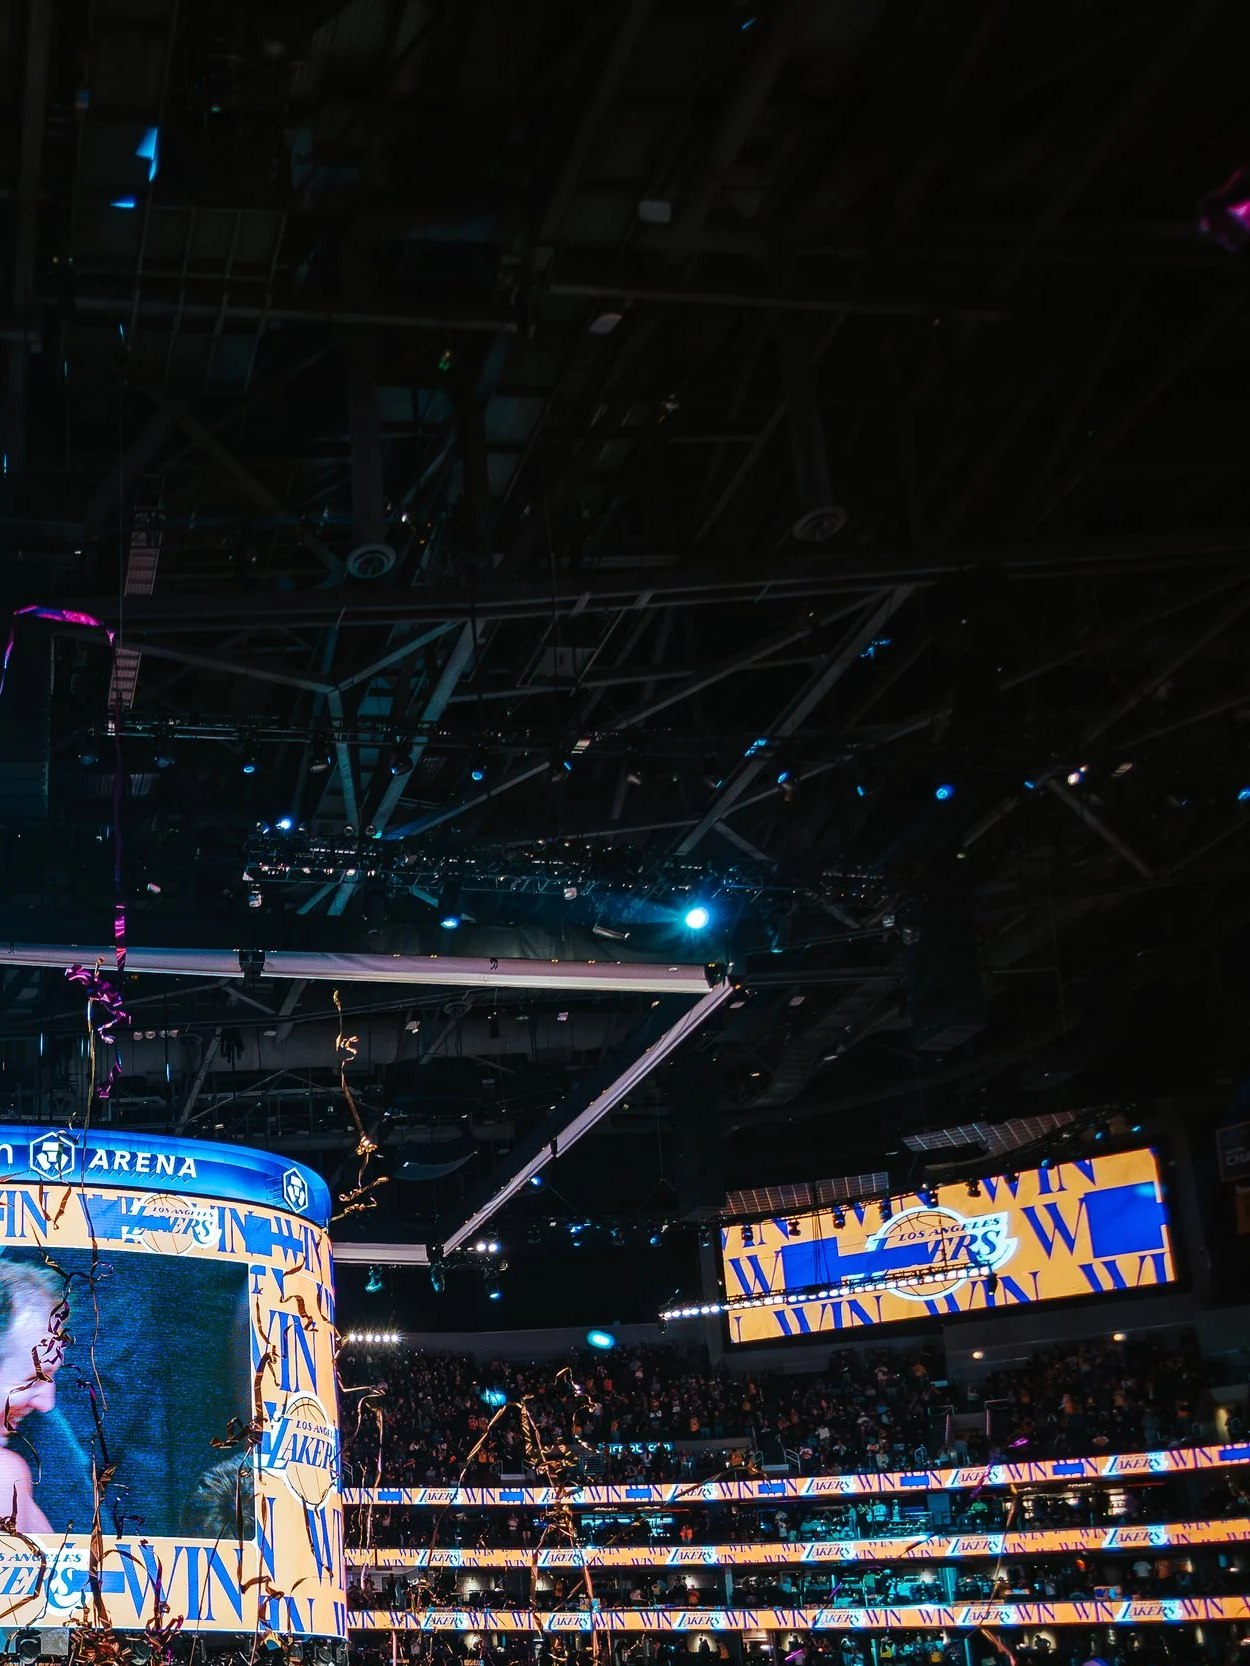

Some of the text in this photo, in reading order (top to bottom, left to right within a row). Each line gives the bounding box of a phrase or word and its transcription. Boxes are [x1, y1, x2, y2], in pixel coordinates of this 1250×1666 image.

[88, 1149, 198, 1179] ARENA
[898, 1217, 1001, 1242] LOS ANGELES
[806, 1478, 851, 1494] LAKERS
[1107, 1454, 1163, 1474] LAKERS
[8, 1552, 83, 1564] ANGELES
[419, 1550, 461, 1565] LAKERS
[671, 1549, 714, 1564] LAKERS
[806, 1544, 851, 1560] LAKERS
[949, 1537, 998, 1554] LAKERS
[1107, 1528, 1162, 1546] LAKERS
[114, 1543, 245, 1624] WIN
[423, 1613, 465, 1629] LAKERS
[549, 1614, 589, 1630] LAKERS
[678, 1612, 722, 1629] LAKERS
[816, 1610, 861, 1627] LAKERS
[959, 1608, 1011, 1625] LAKERS
[1121, 1601, 1177, 1621] LAKERS
